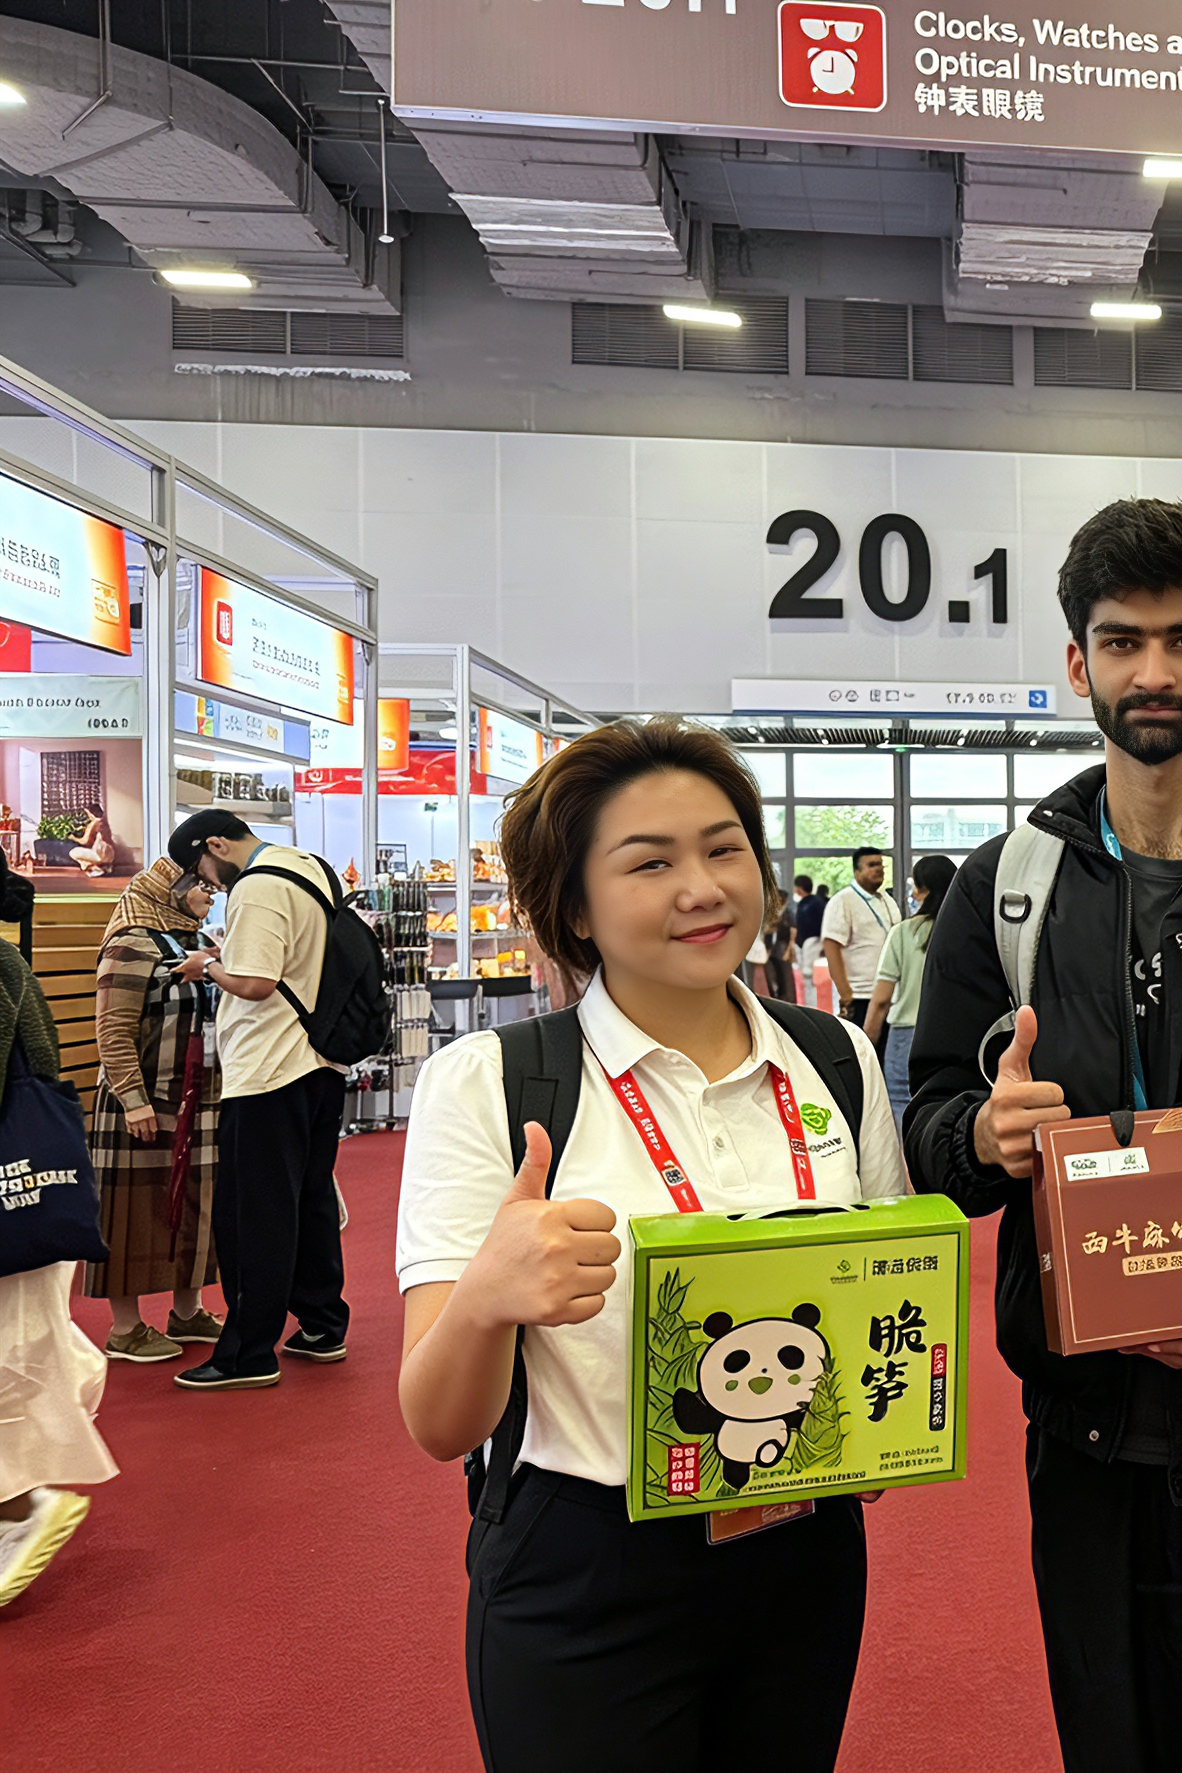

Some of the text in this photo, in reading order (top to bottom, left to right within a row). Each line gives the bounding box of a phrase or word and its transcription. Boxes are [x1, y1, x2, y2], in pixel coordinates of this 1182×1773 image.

[914, 10, 1025, 48] Clocks,
[1032, 18, 1159, 53] Watches
[914, 47, 1020, 82] Optical
[914, 82, 1045, 122] 钟表眼镜
[765, 509, 1009, 623] 20.1
[860, 1298, 928, 1423] 脆笋
